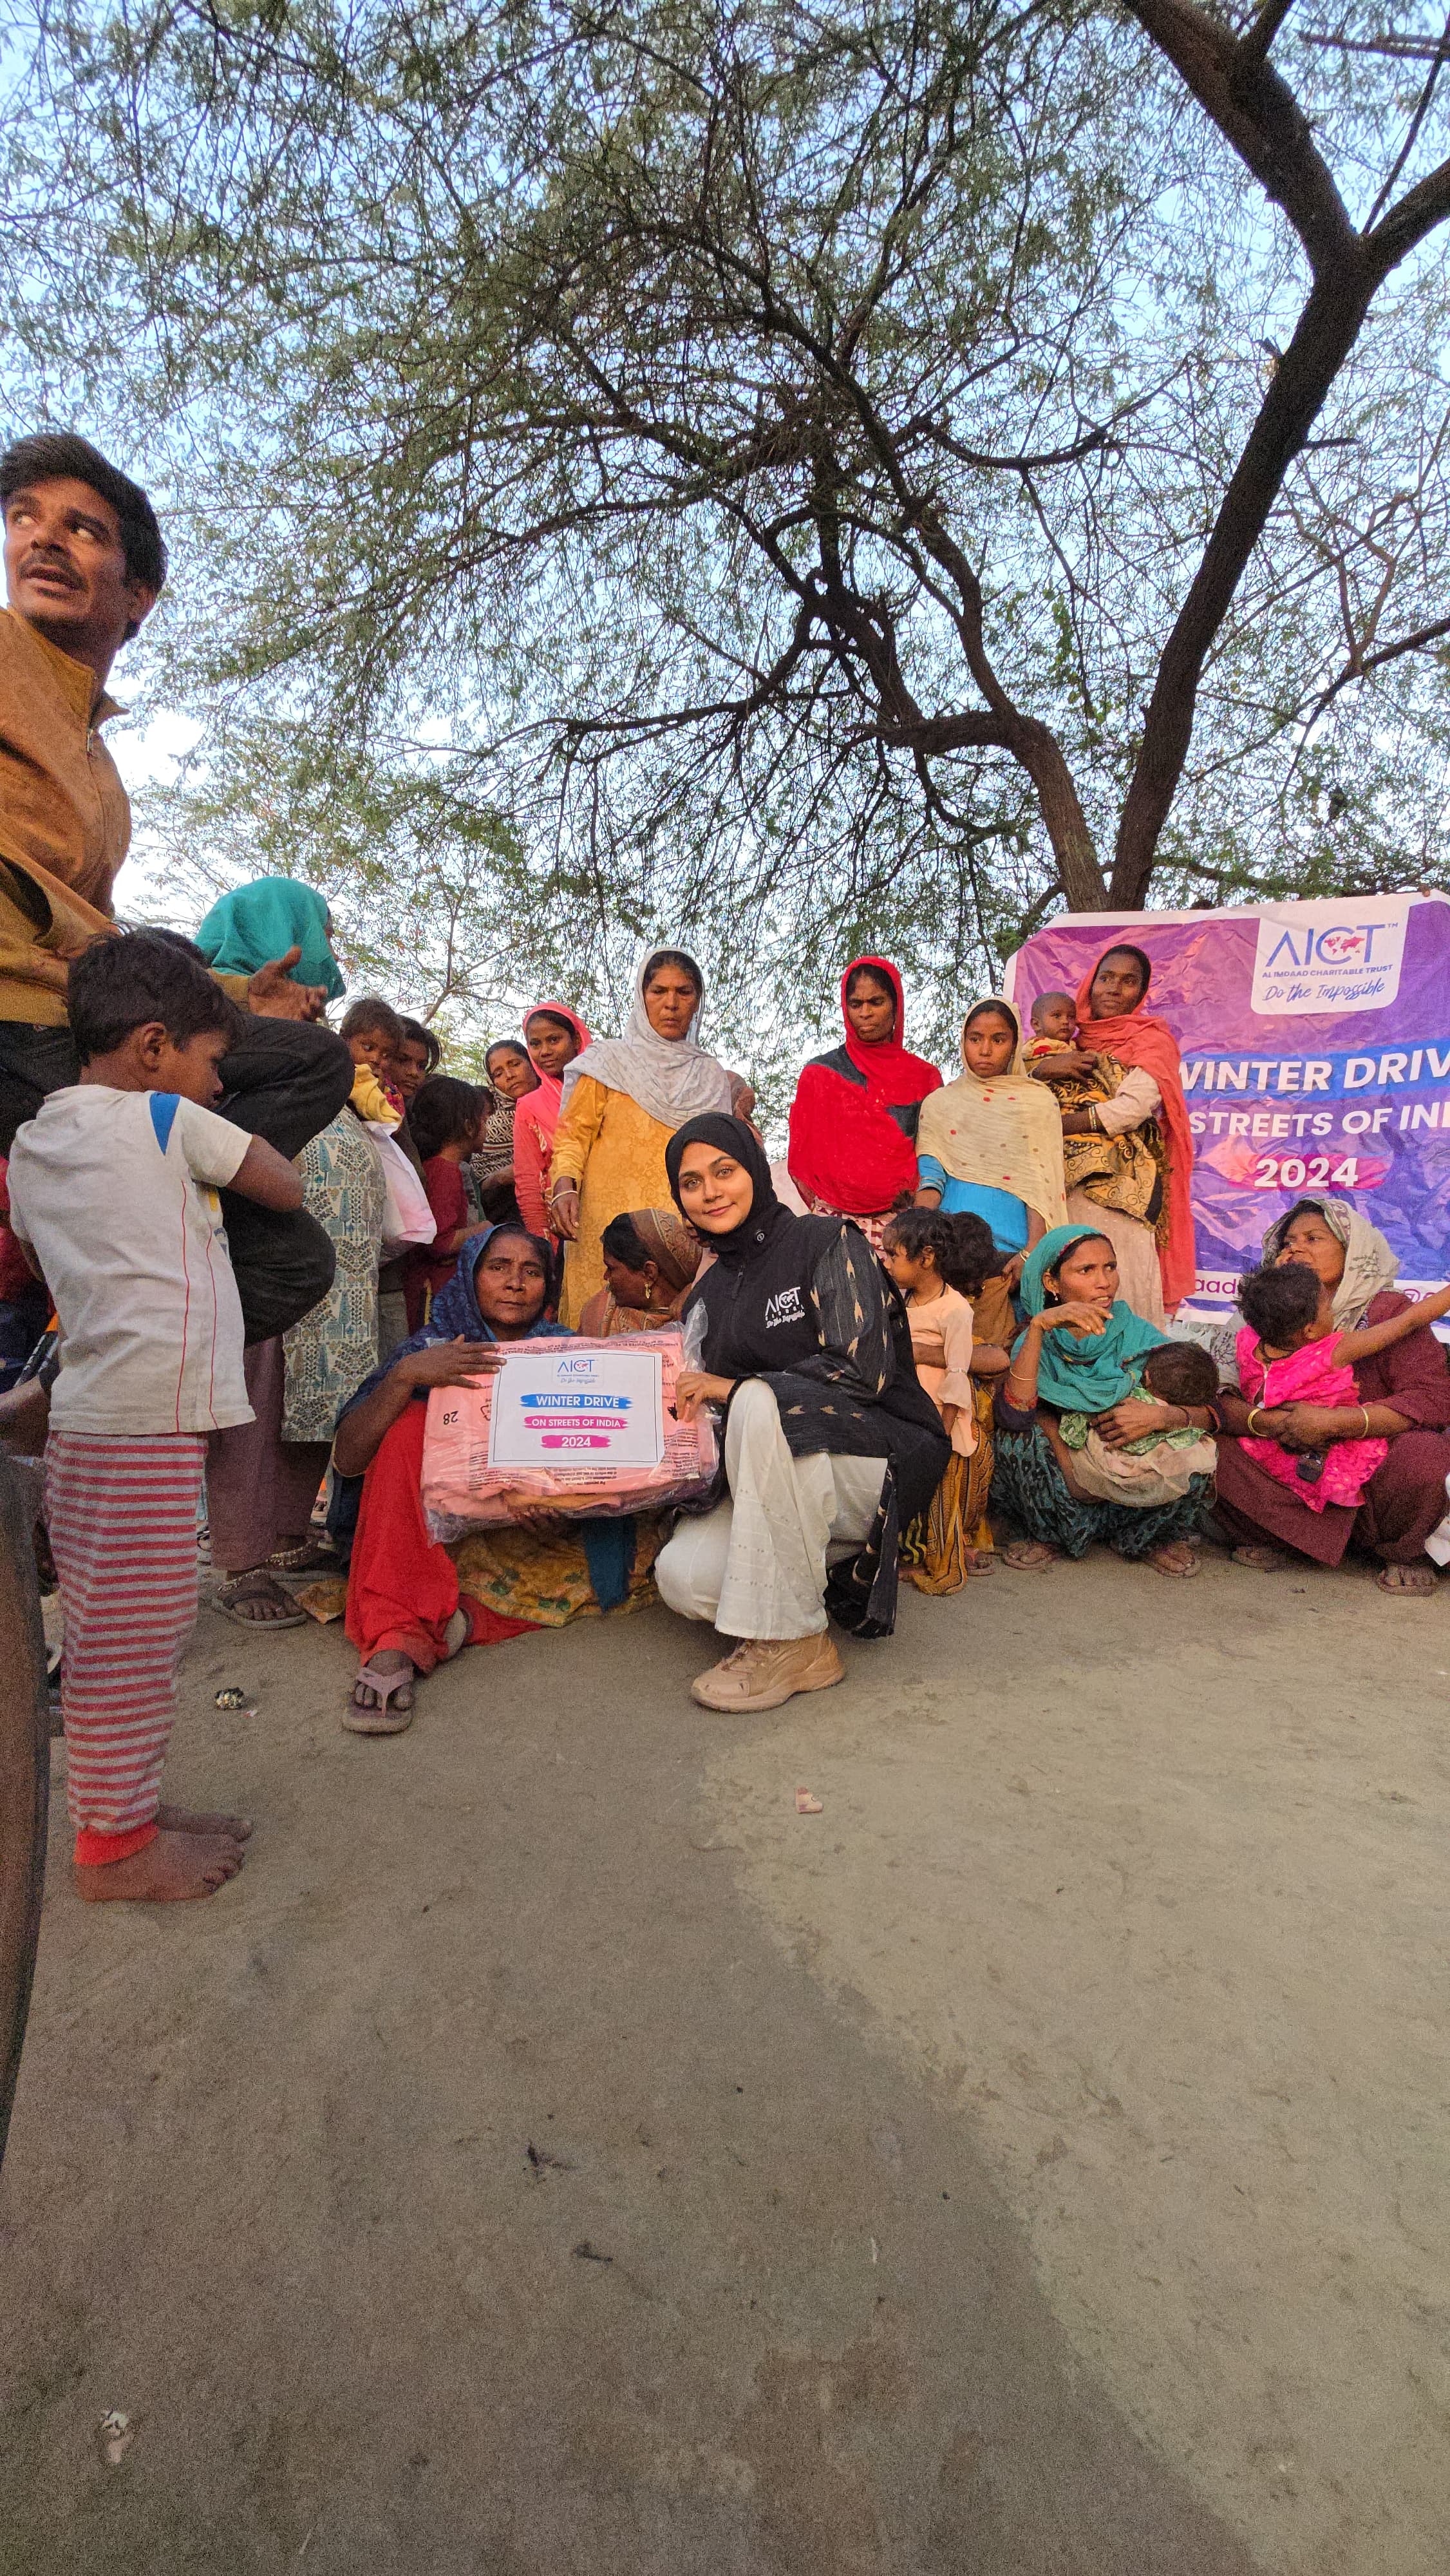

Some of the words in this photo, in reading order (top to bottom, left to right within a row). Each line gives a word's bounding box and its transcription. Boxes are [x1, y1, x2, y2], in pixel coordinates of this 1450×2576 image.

[1265, 923, 1386, 967] AICT
[1310, 968, 1364, 976] CHARITABLE
[1365, 964, 1393, 973] TRUST
[1262, 985, 1285, 1001] Do
[1286, 982, 1312, 1003] the
[1315, 977, 1386, 1002] Impossible
[1189, 1112, 1333, 1138] STREETS
[1341, 1107, 1393, 1135] OF
[1254, 1157, 1359, 1188] 2024
[558, 1359, 596, 1373] AICT
[536, 1396, 581, 1406] WINTER
[584, 1396, 619, 1408] DRIVE
[443, 1410, 459, 1425] 28
[596, 1419, 621, 1428] INDIA
[561, 1436, 592, 1447] 2024
